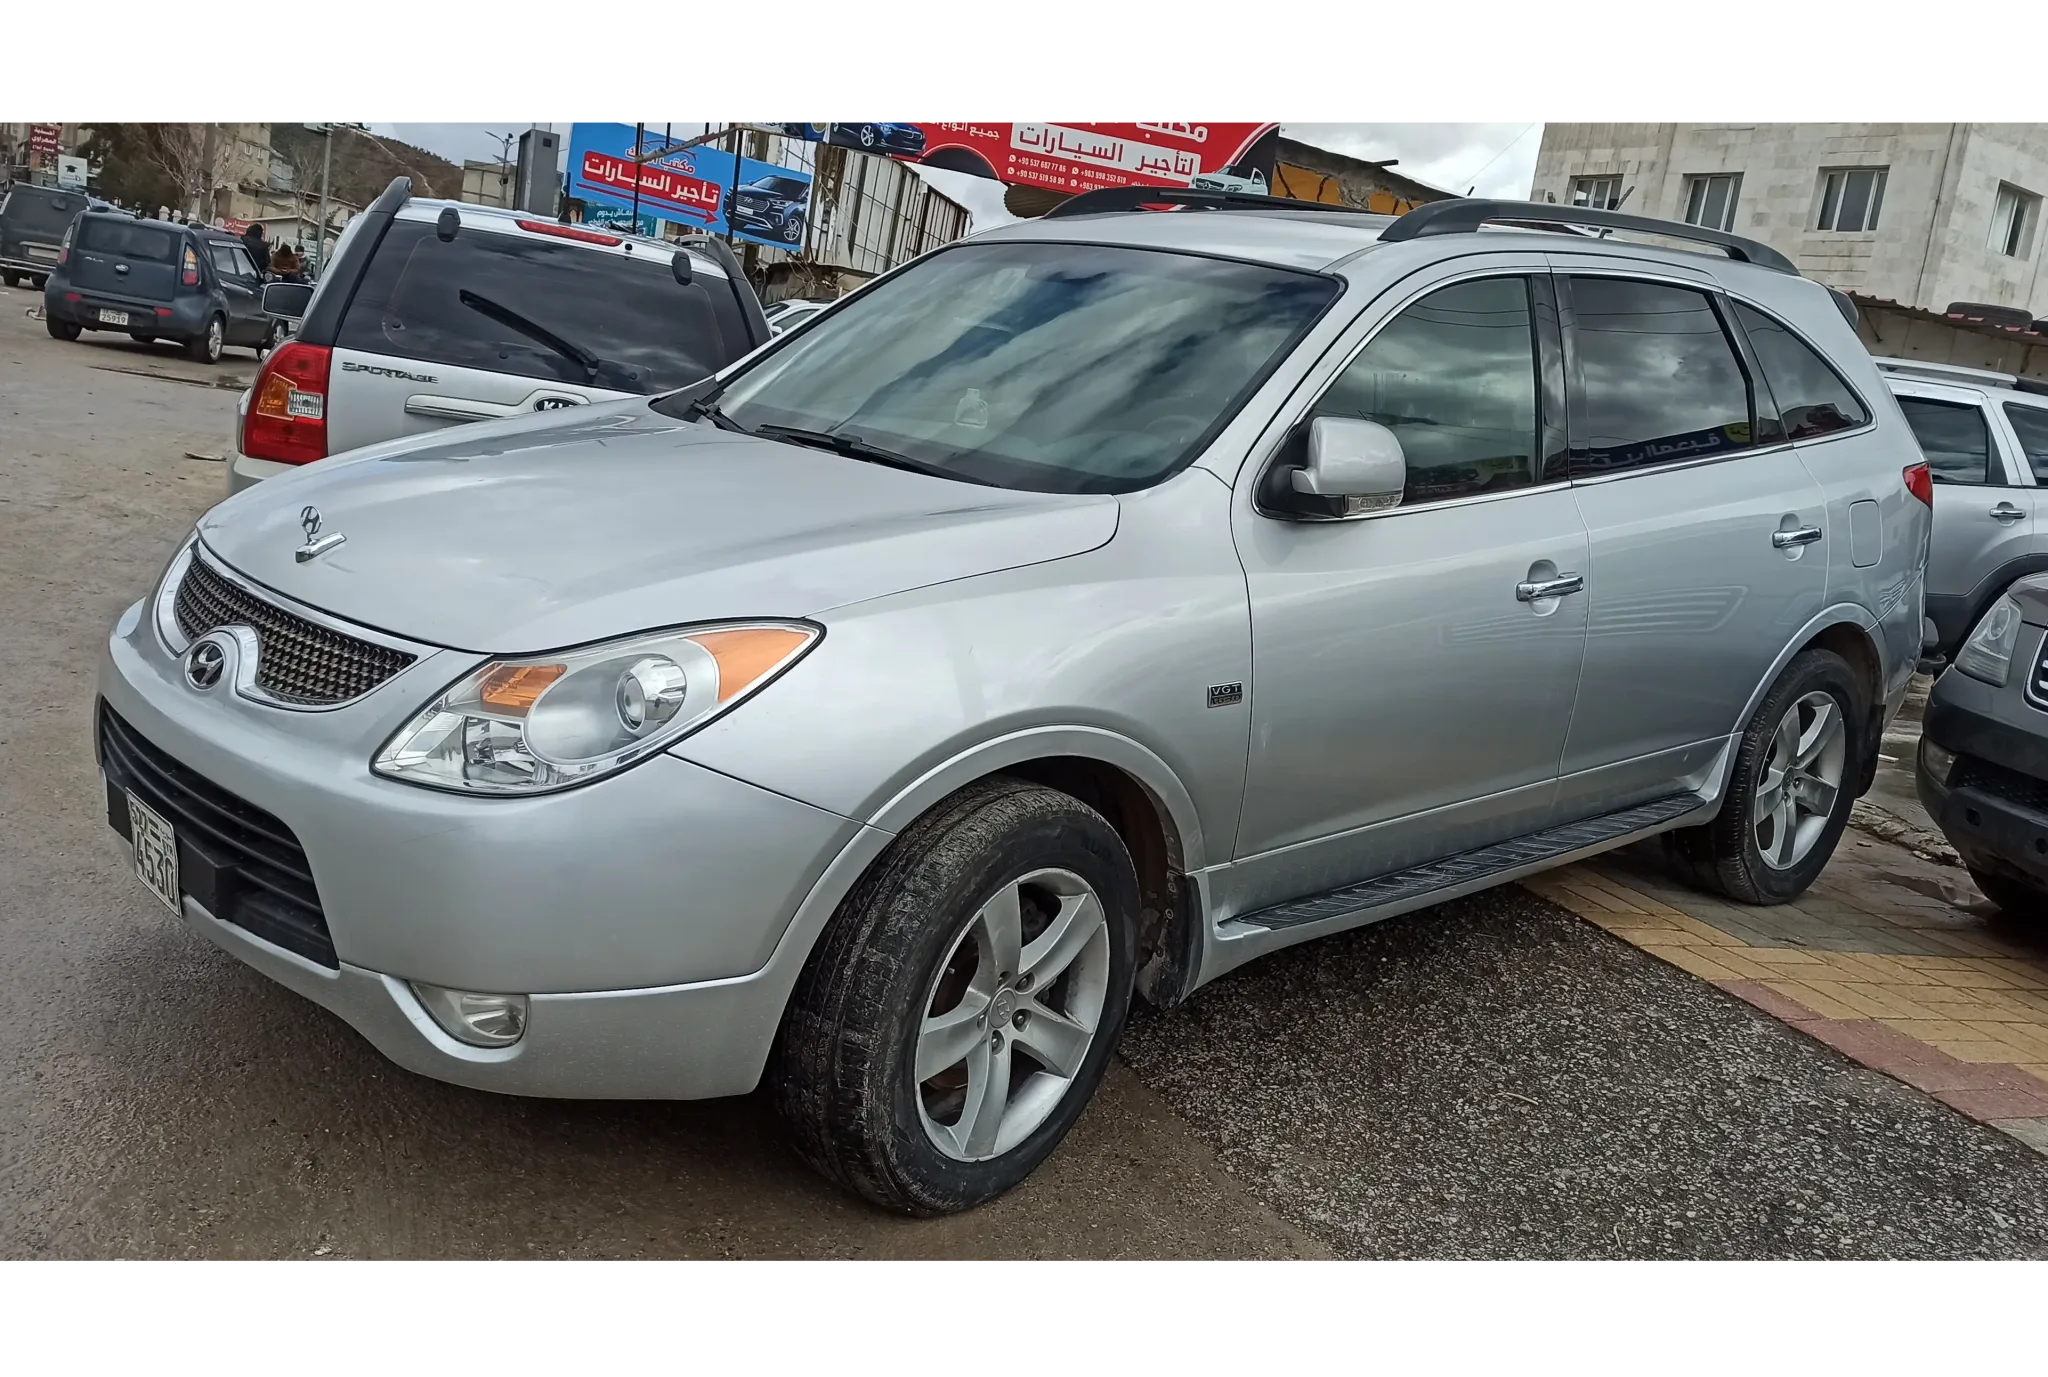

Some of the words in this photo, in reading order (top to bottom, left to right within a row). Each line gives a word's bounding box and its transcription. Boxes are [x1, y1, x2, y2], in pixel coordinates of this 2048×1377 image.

[970, 125, 1000, 141] جميع
[1019, 126, 1123, 163] السيارات
[660, 157, 695, 175] مكتب
[1135, 150, 1194, 176] لتأجير
[584, 158, 671, 192] السيارات
[671, 182, 719, 204] تأجير
[341, 361, 440, 384] SPORTAGE
[1212, 683, 1241, 695] VGT
[136, 829, 178, 907] 4530
